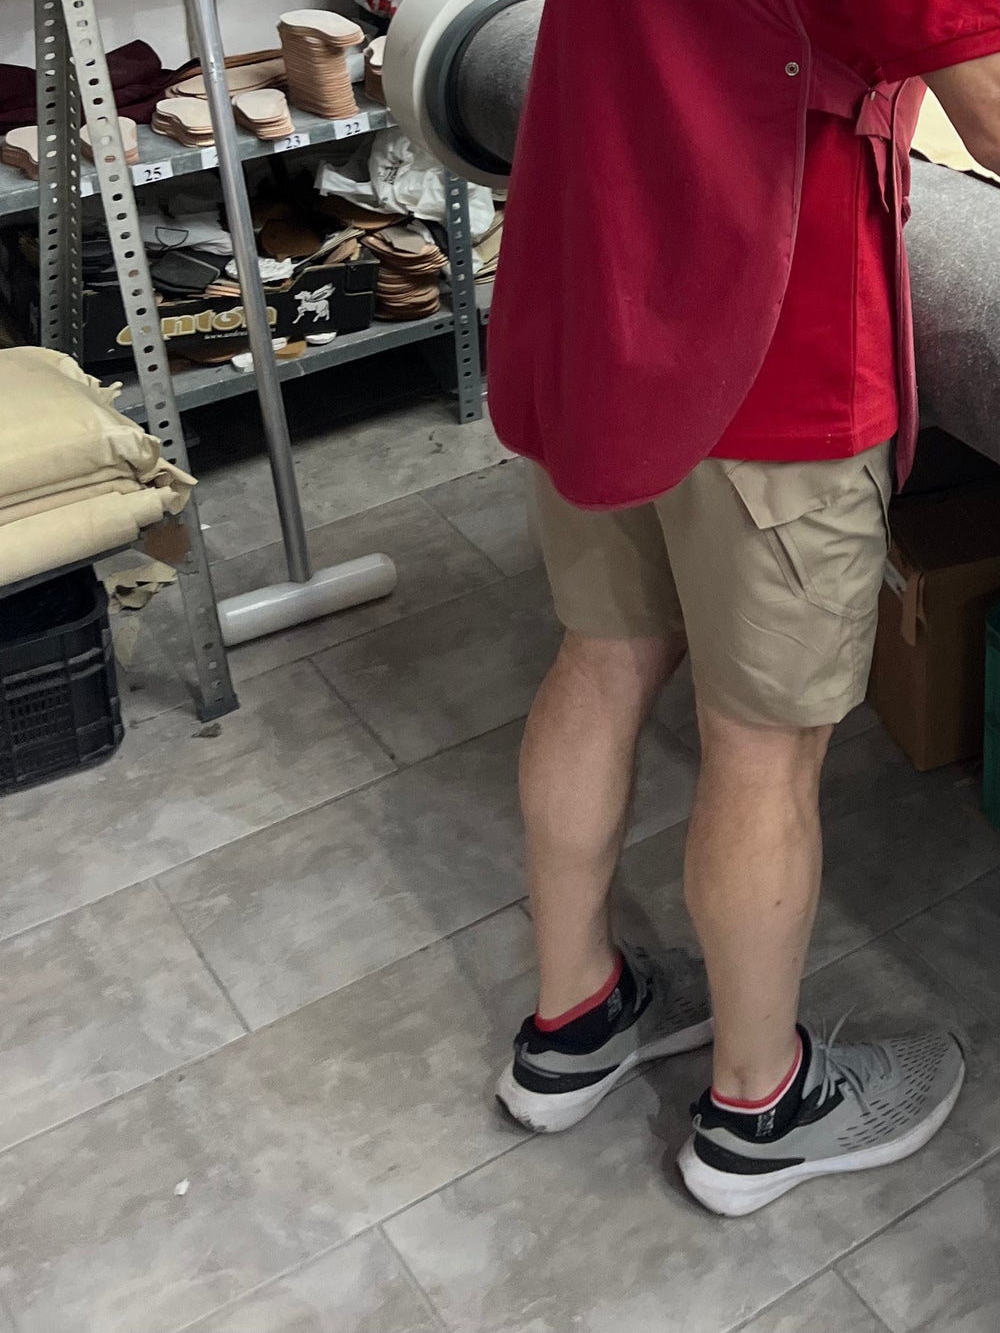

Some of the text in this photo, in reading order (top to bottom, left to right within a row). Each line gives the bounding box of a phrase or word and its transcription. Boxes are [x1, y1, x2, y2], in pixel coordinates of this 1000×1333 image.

[345, 120, 361, 136] 22
[284, 136, 300, 150] 23
[143, 166, 162, 182] 25
